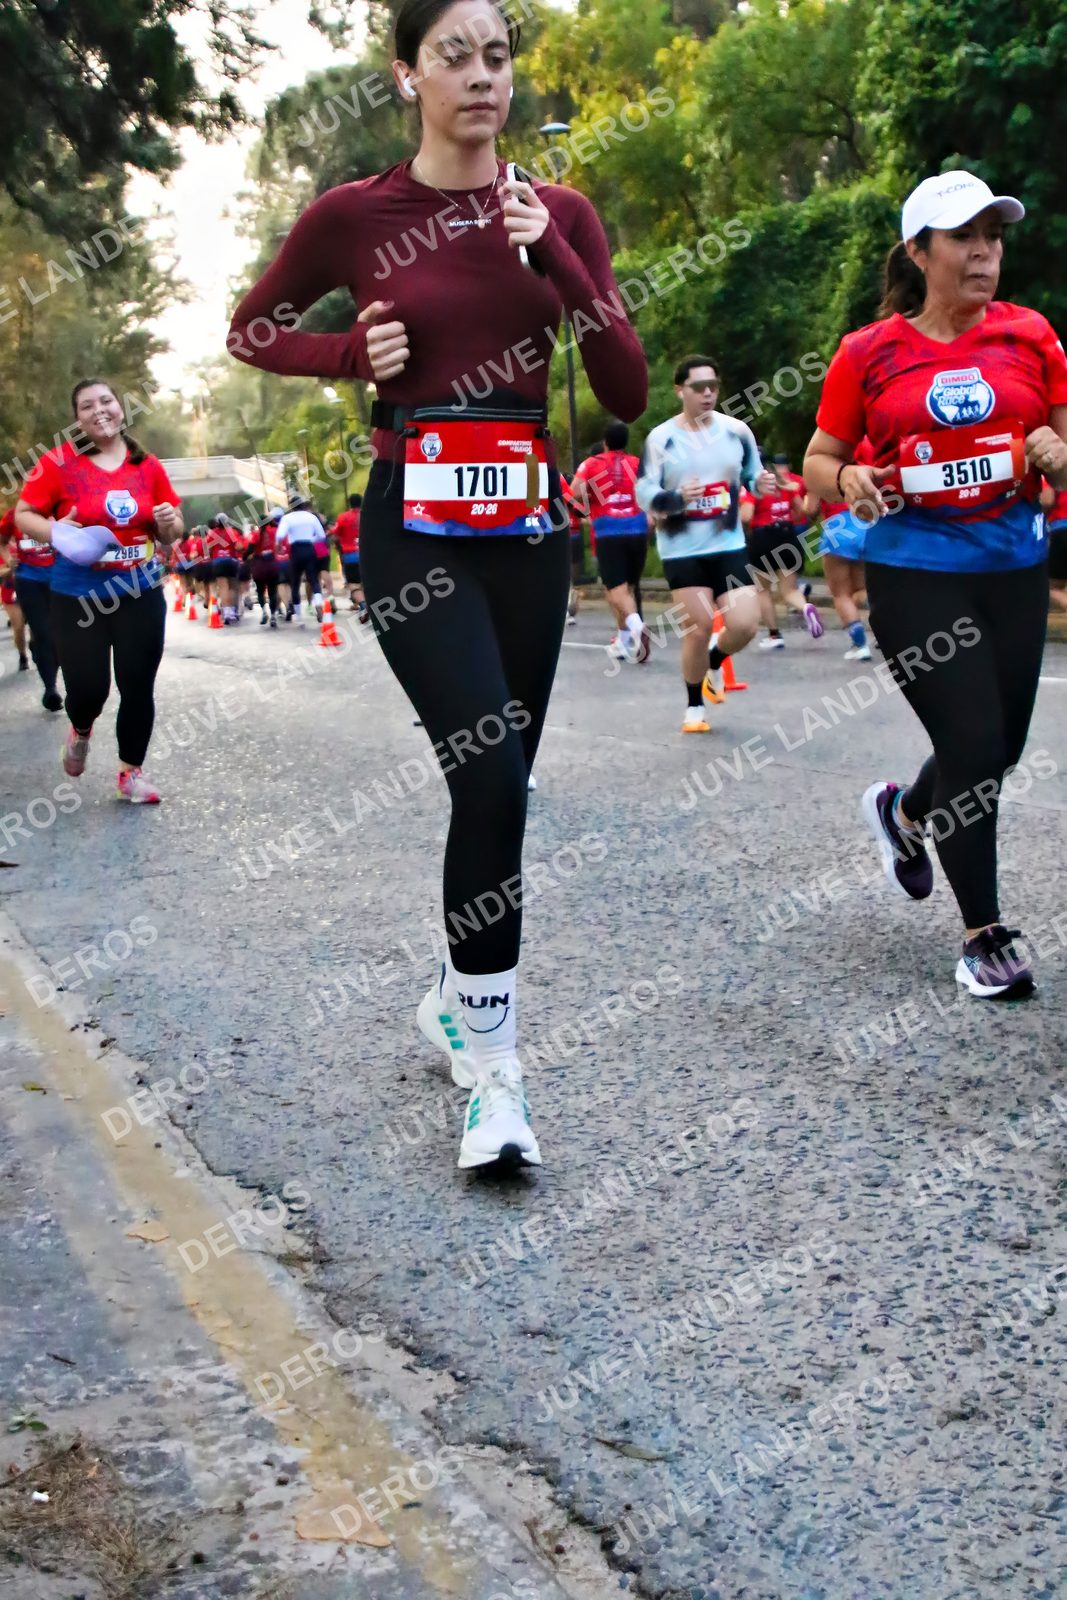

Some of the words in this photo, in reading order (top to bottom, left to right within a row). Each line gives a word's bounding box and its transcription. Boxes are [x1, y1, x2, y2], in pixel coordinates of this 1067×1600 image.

[941, 374, 975, 385] BIMBO
[943, 385, 977, 397] Global
[937, 395, 966, 407] Race
[942, 457, 992, 488] 3510
[454, 466, 508, 497] 1701
[114, 546, 140, 560] 2985
